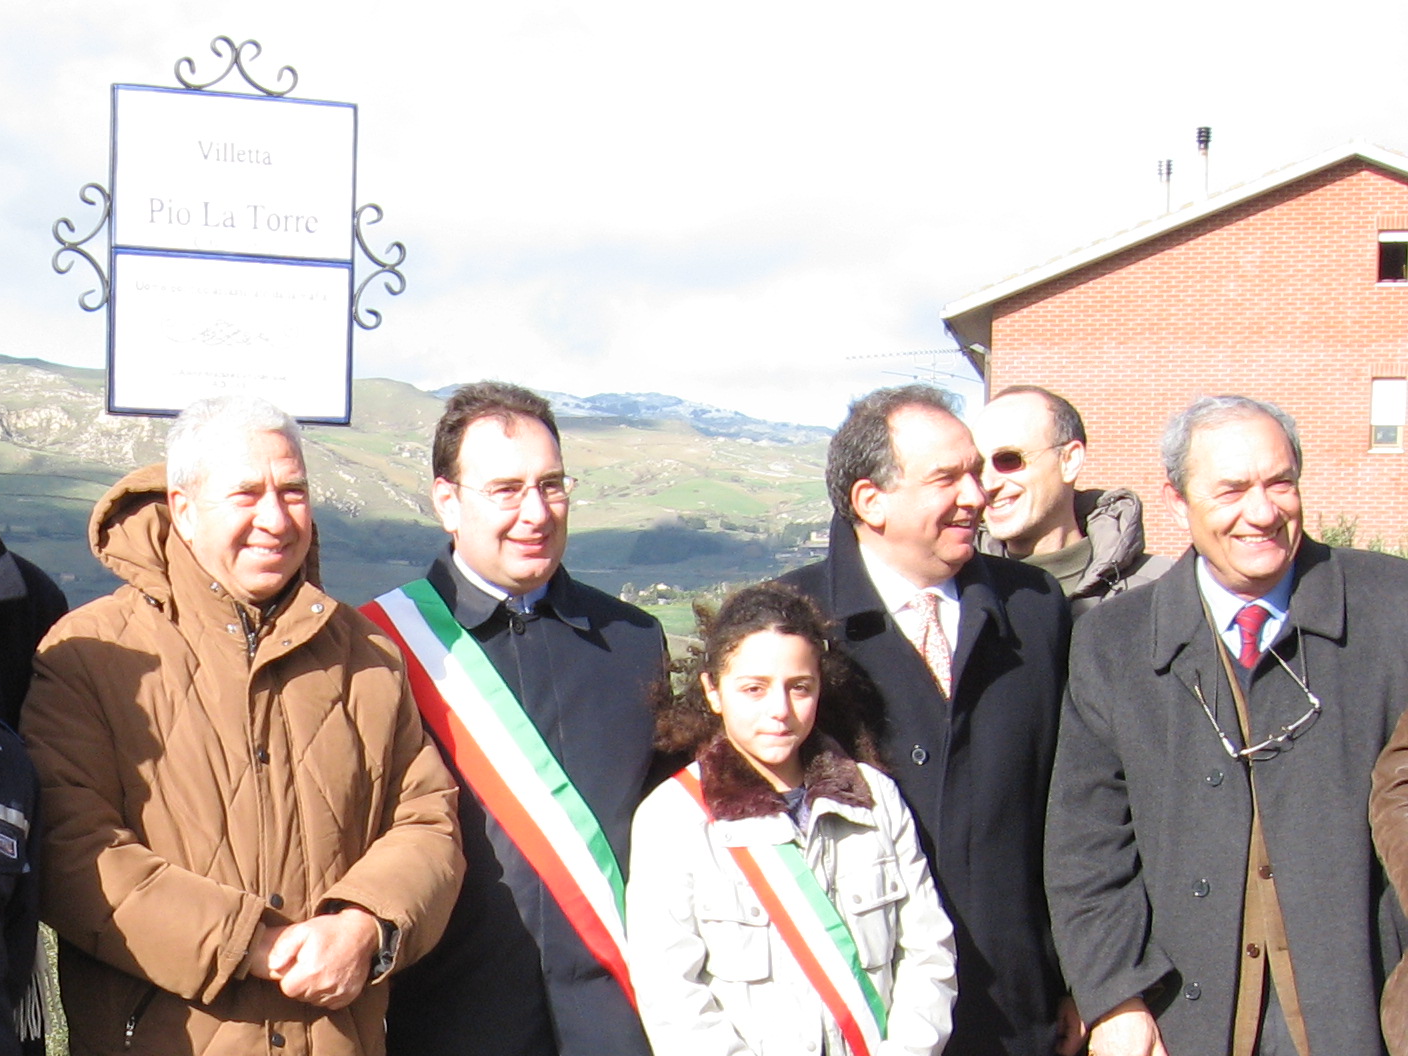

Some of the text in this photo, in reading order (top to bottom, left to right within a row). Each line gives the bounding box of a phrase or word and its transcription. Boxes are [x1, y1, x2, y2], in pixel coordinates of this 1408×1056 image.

[197, 140, 273, 166] Villetta
[148, 197, 319, 234] Pio La Torre
